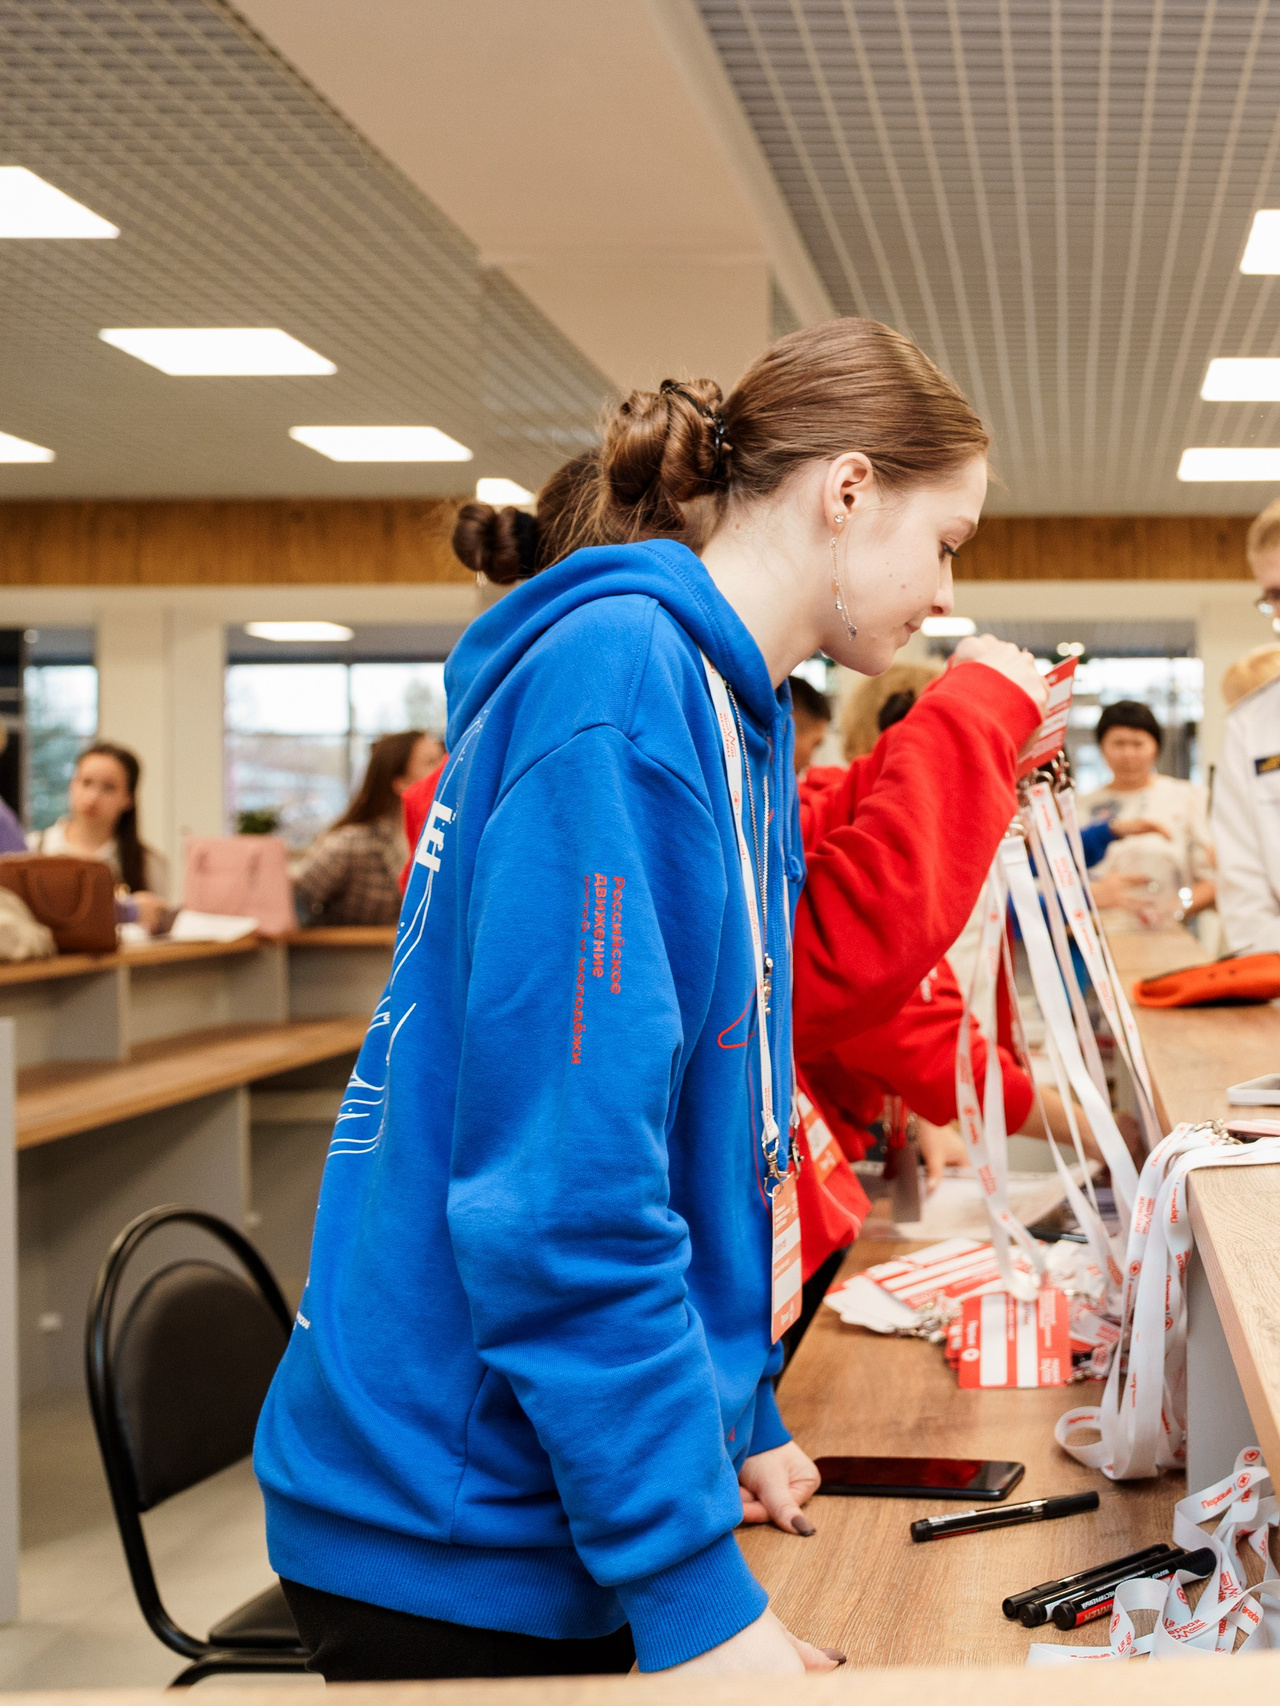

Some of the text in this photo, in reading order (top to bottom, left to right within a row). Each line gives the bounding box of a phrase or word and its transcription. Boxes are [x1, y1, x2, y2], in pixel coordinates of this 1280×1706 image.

[610, 876, 625, 995] Российское
[571, 957, 587, 1065] молодёжи
[1167, 1619, 1201, 1634] ервая
